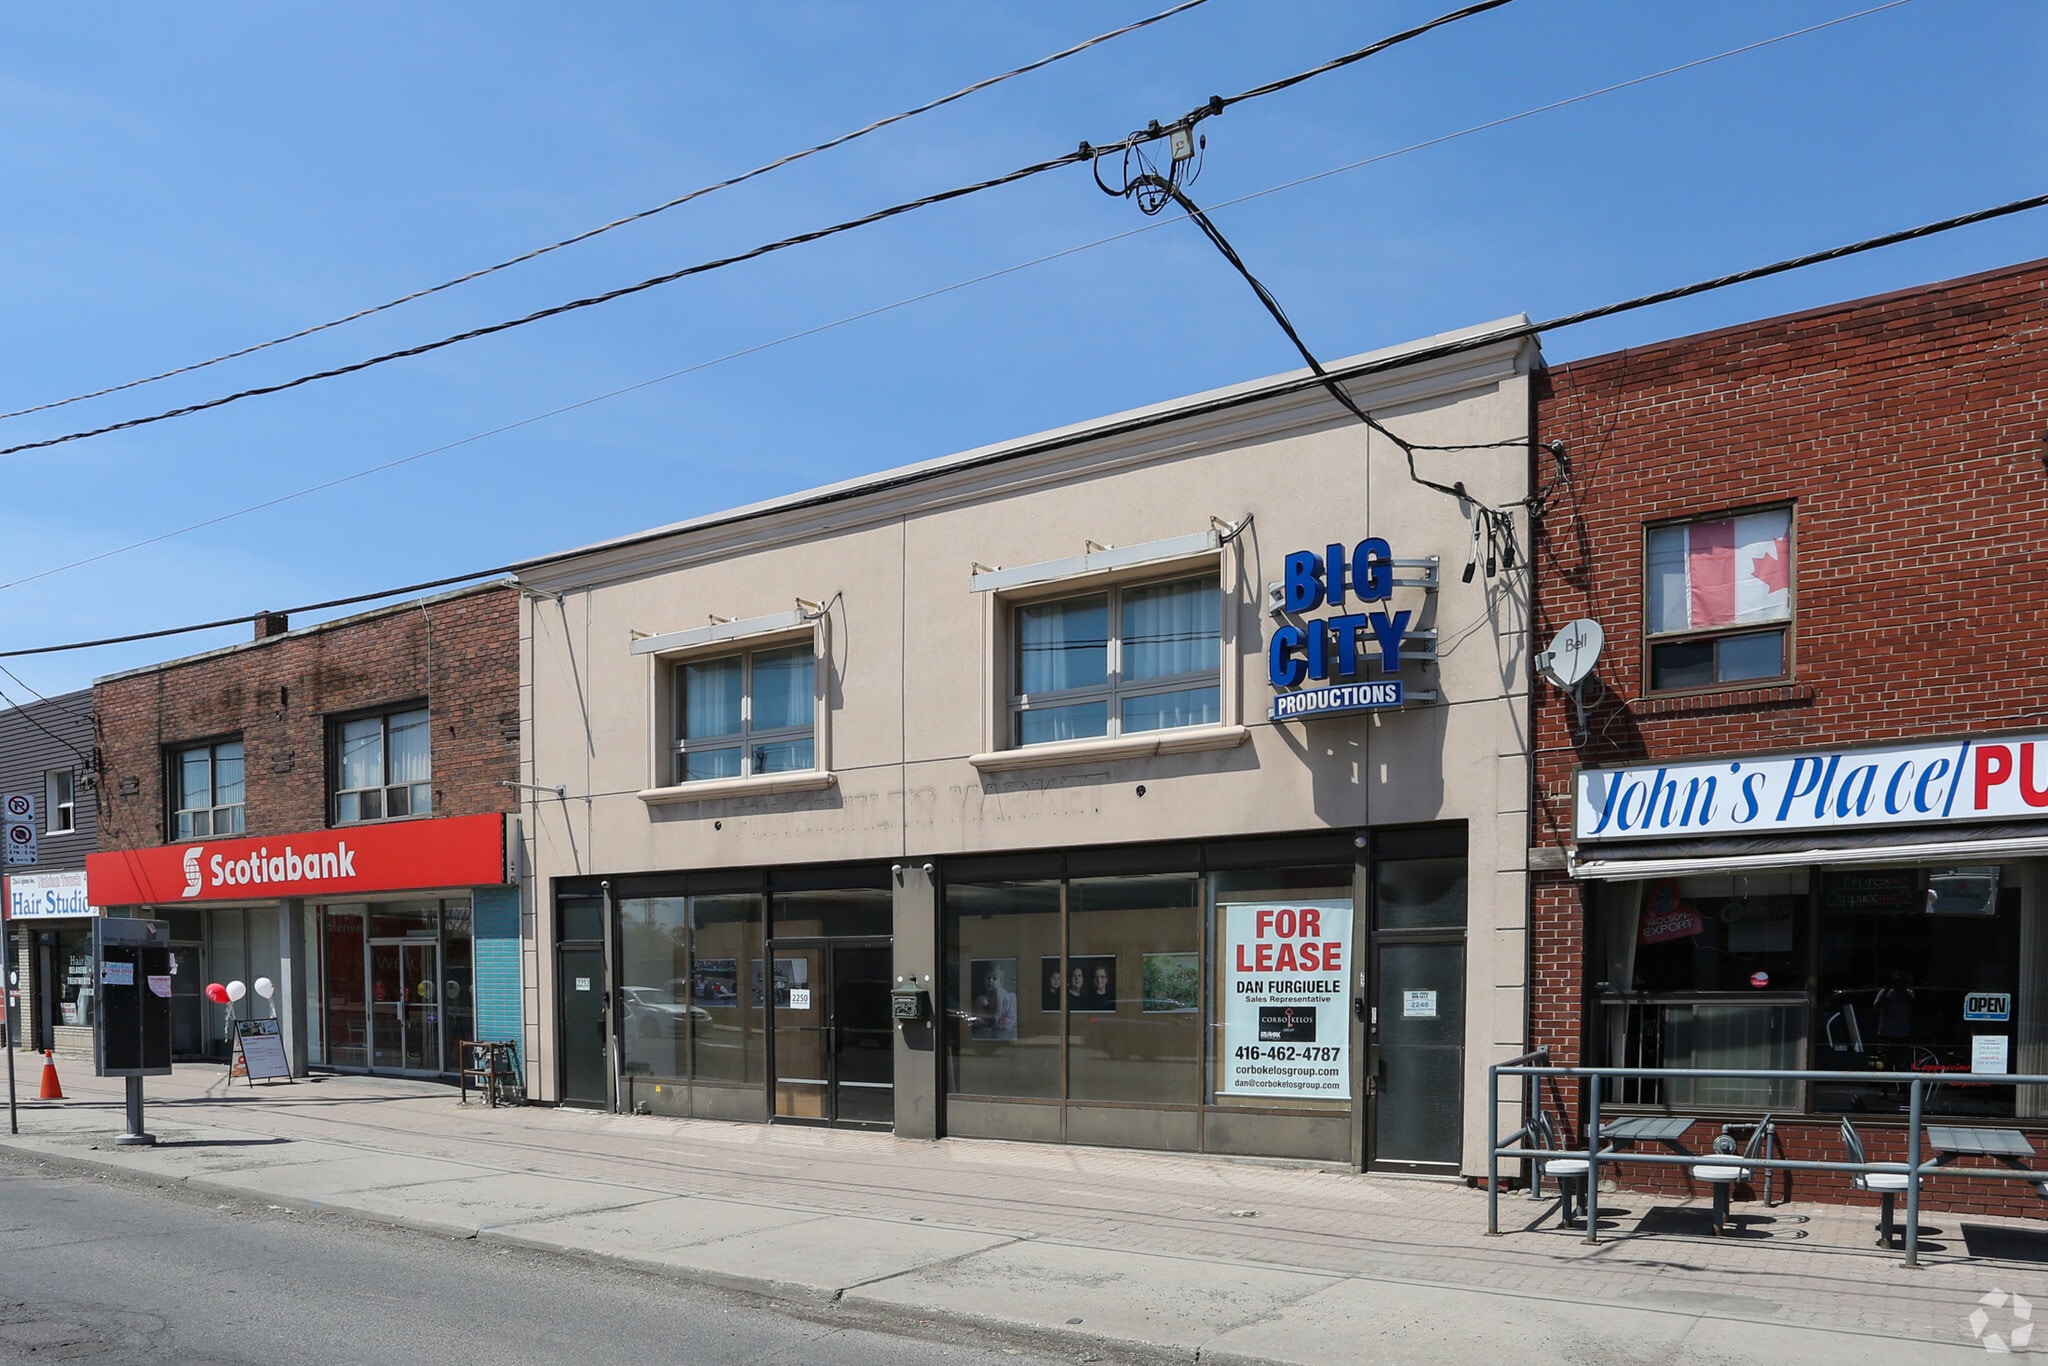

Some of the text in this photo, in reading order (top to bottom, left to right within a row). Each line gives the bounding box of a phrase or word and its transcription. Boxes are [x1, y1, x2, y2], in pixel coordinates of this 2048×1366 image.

[1285, 537, 1392, 613] BIG
[1269, 610, 1412, 687] CITY
[1566, 633, 1587, 652] Bell
[1278, 684, 1397, 715] PRODUCTIONS
[1587, 761, 1766, 834] John's
[210, 841, 356, 887] Scotiabank
[12, 889, 91, 915] Hair Studio
[1256, 909, 1320, 938] FOR
[1643, 918, 1694, 937] EXPORT
[1647, 912, 1688, 926] MOLSON
[70, 955, 84, 966] Hair
[1237, 942, 1341, 971] LEASE
[1236, 980, 1340, 993] DAN FURGIUELE
[792, 994, 808, 1002] 2250
[1245, 995, 1331, 1003] Sales Representative
[1969, 997, 2006, 1013] OPEN
[1235, 1046, 1340, 1061] 416-462-4787
[1236, 1065, 1339, 1077] corbokelosgroup.com
[1235, 1079, 1340, 1090] dan@corbokelosgroup.com
